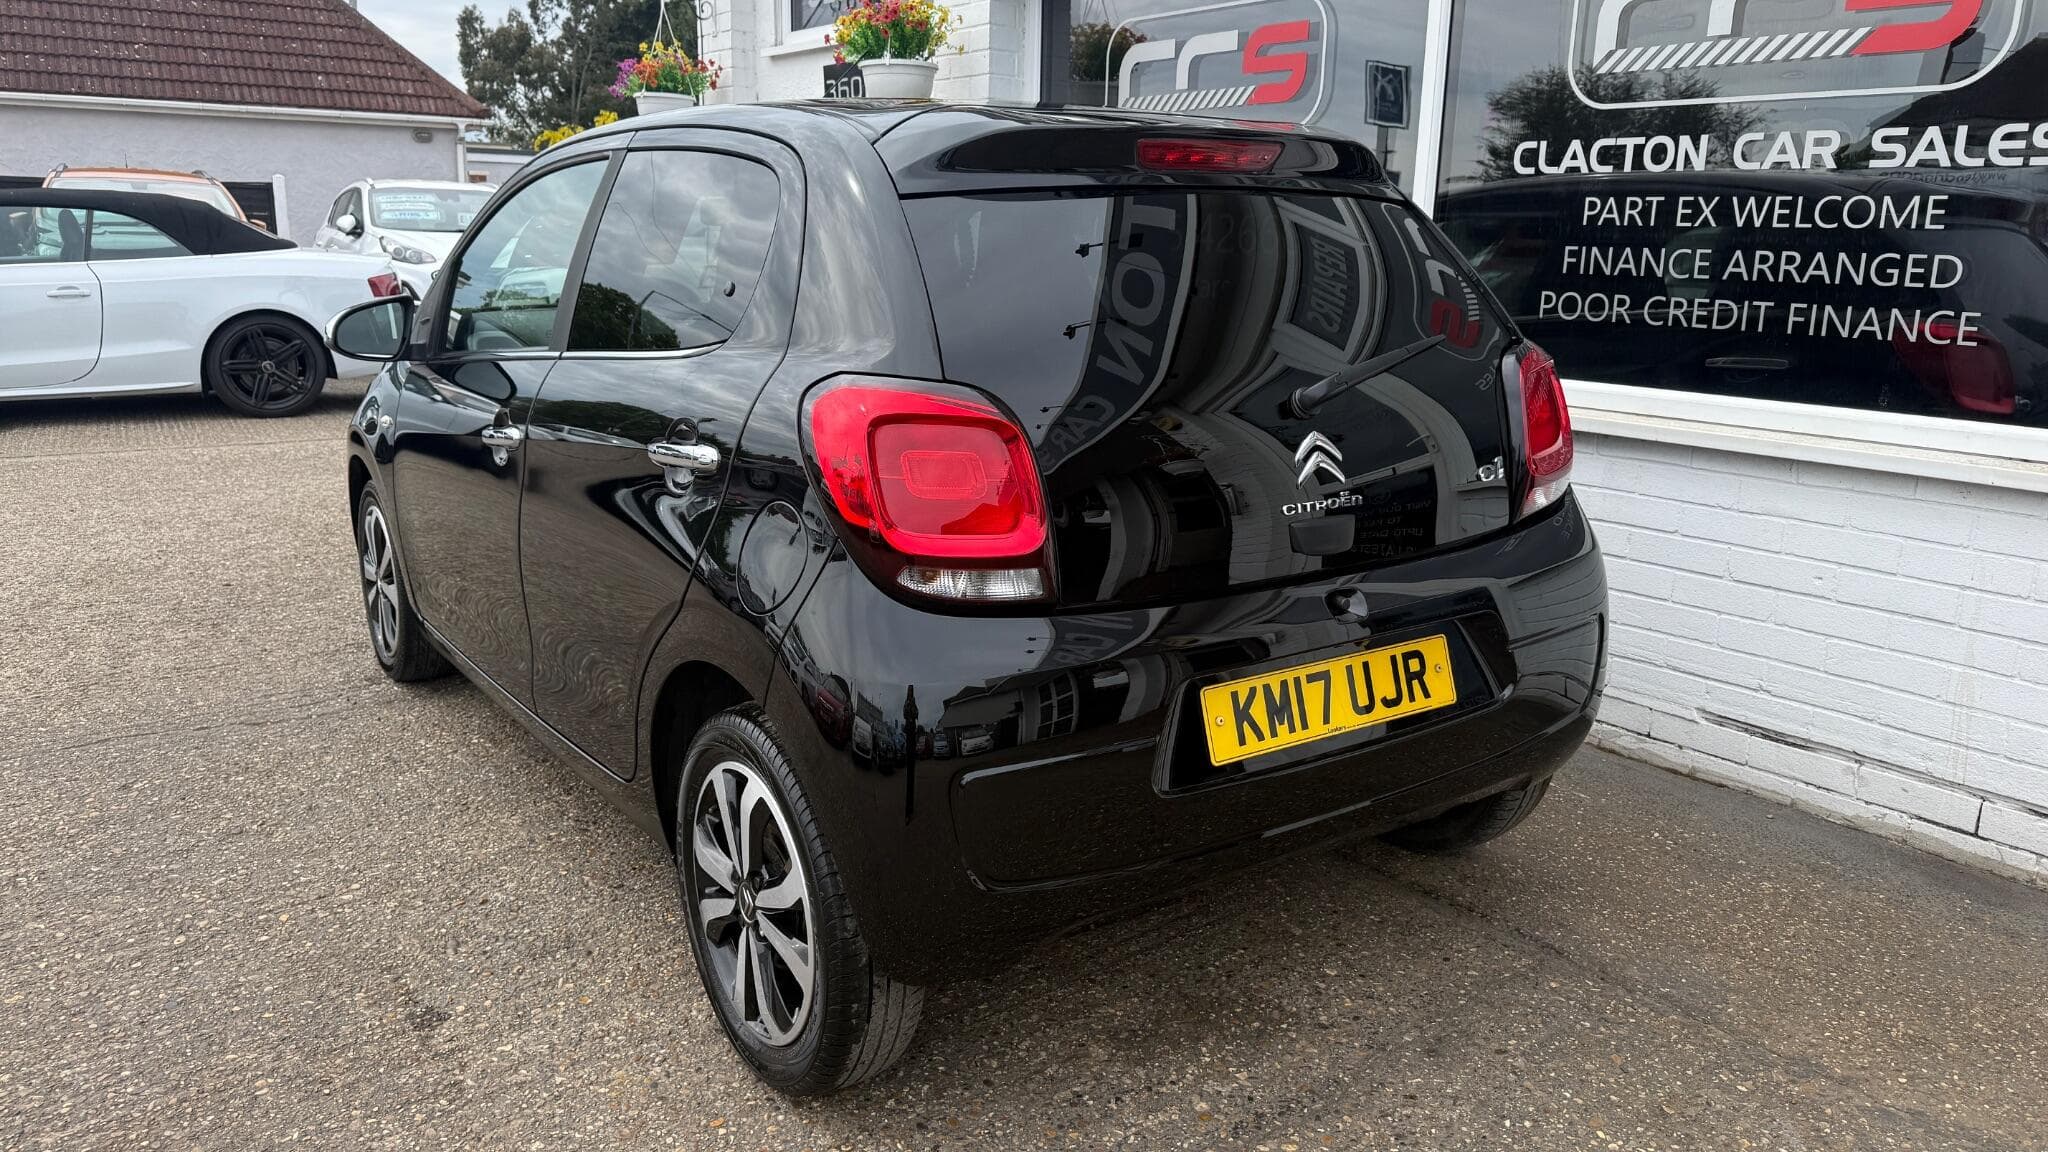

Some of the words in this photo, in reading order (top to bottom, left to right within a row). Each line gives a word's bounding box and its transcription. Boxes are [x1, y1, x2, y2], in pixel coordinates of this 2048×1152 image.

[826, 76, 862, 98] 360
[1513, 134, 1709, 174] CLACTON
[1733, 129, 1841, 170] CAR
[1582, 196, 1665, 226] PART
[1675, 196, 1721, 227] EX
[1731, 195, 1949, 230] WELCOME
[1562, 245, 1712, 279] FINANCE
[1721, 249, 1964, 288] ARRANGED
[1538, 290, 1631, 324] POOR
[1643, 296, 1775, 333] CREDIT
[1786, 303, 1982, 346] FINANCE
[1230, 669, 1332, 747] KM17
[1345, 650, 1432, 716] UJR
